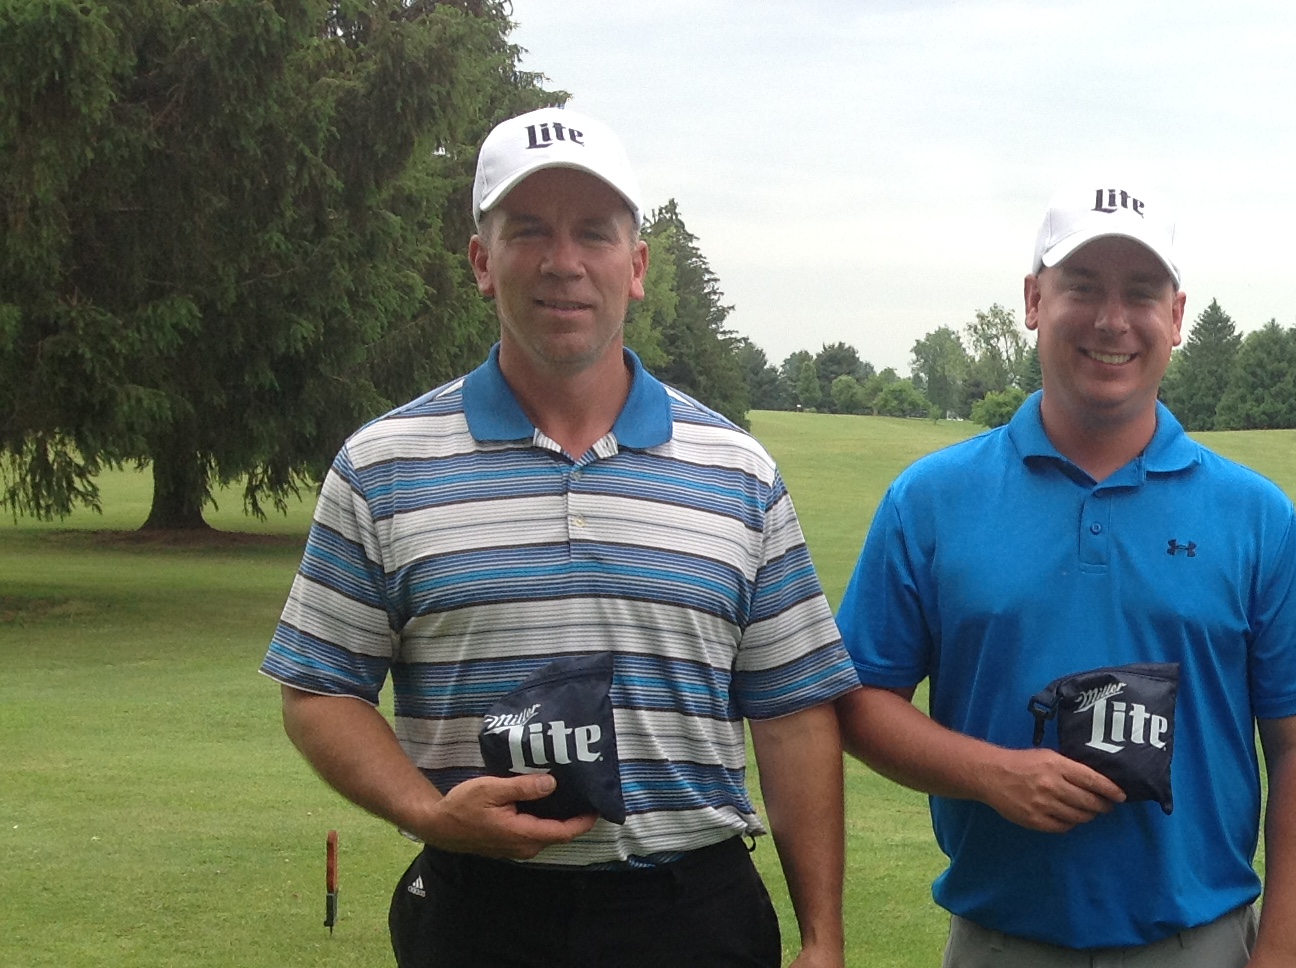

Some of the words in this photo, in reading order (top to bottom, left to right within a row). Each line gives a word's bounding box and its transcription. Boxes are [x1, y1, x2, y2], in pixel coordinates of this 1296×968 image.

[524, 122, 585, 149] Lite
[1091, 188, 1145, 219] Lite
[1074, 682, 1127, 711] Miller
[483, 703, 541, 730] Miller
[1085, 698, 1168, 754] Lite
[506, 720, 602, 774] Lite
